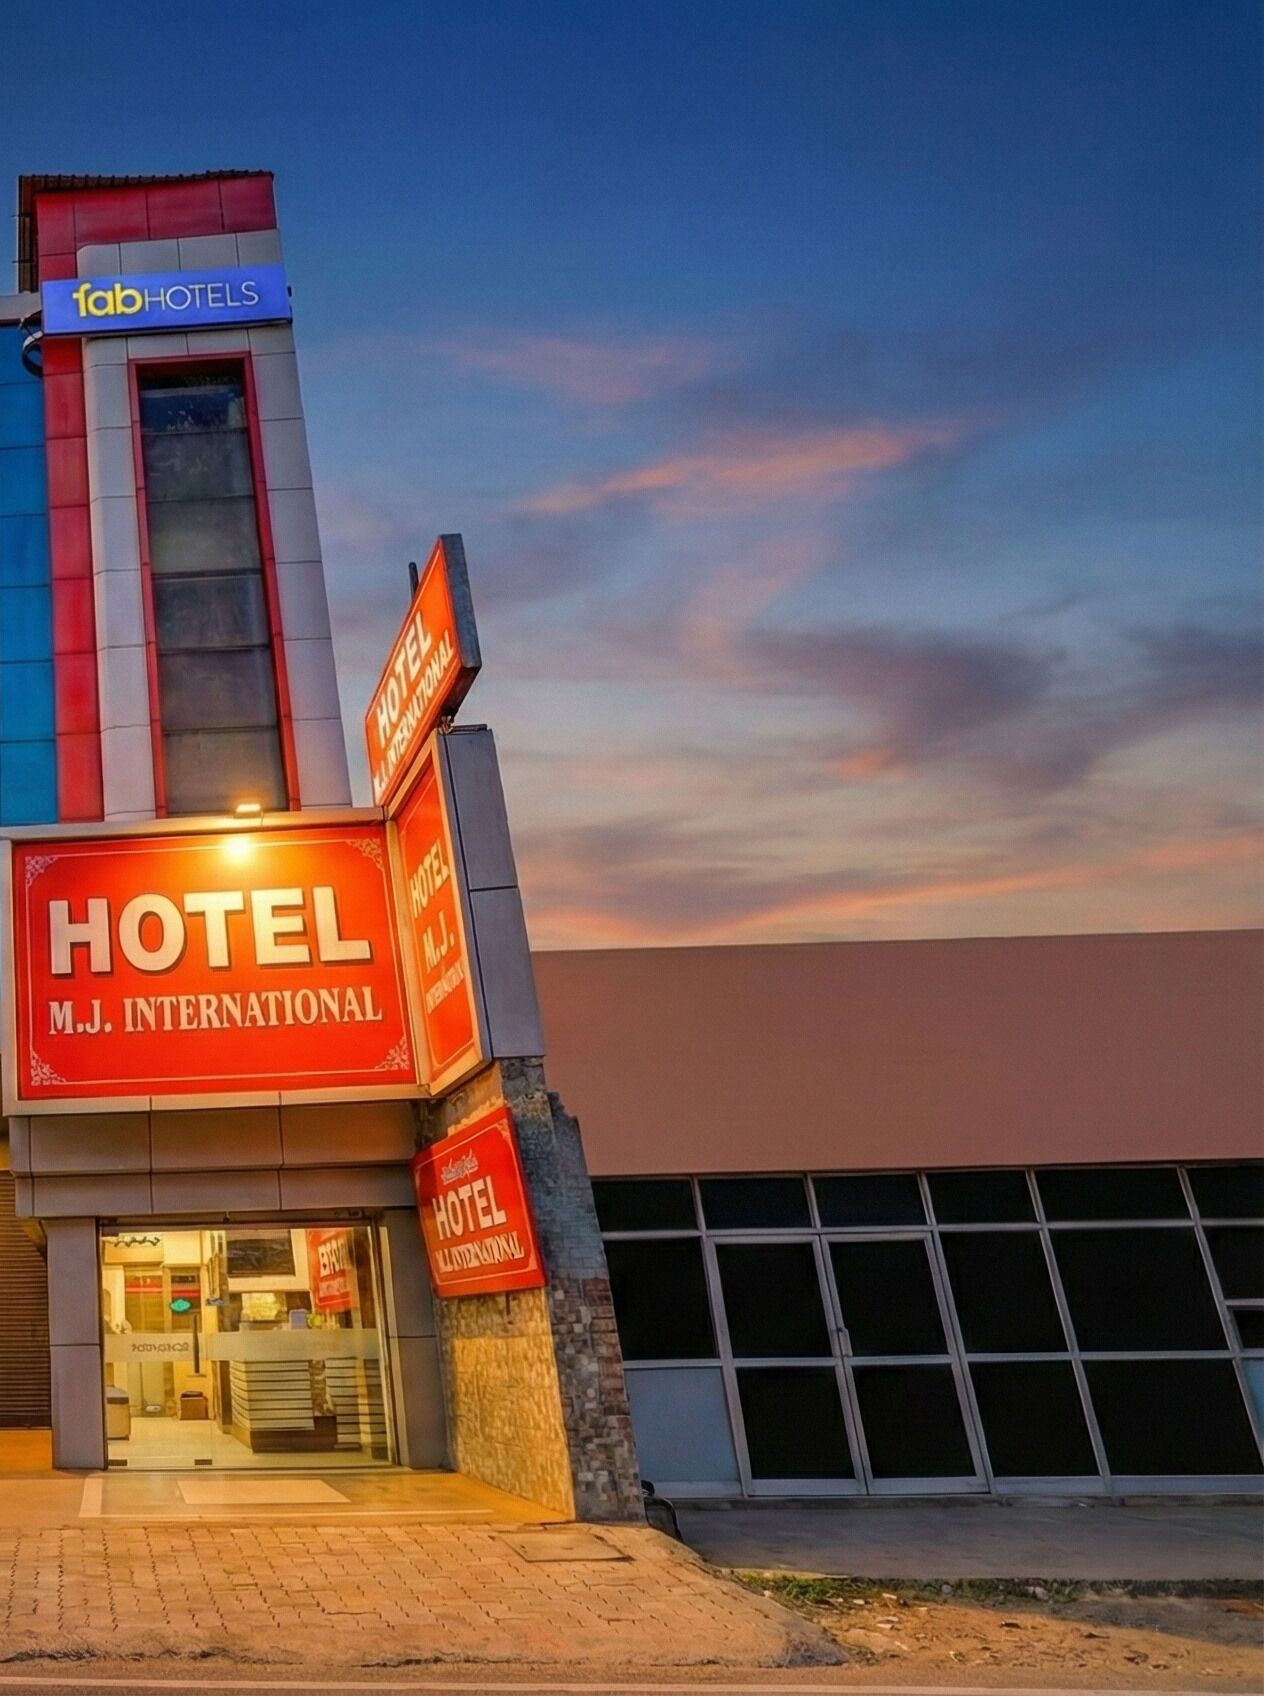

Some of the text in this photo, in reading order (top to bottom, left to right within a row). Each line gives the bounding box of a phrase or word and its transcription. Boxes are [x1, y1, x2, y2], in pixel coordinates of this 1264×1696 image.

[376, 610, 432, 745] HOTEL
[410, 840, 450, 919] HOTEL
[48, 885, 372, 976] HOTEL
[48, 1001, 112, 1035] M.J.
[124, 986, 383, 1033] INTERNATIONAL
[432, 1175, 507, 1241] HOTEL
